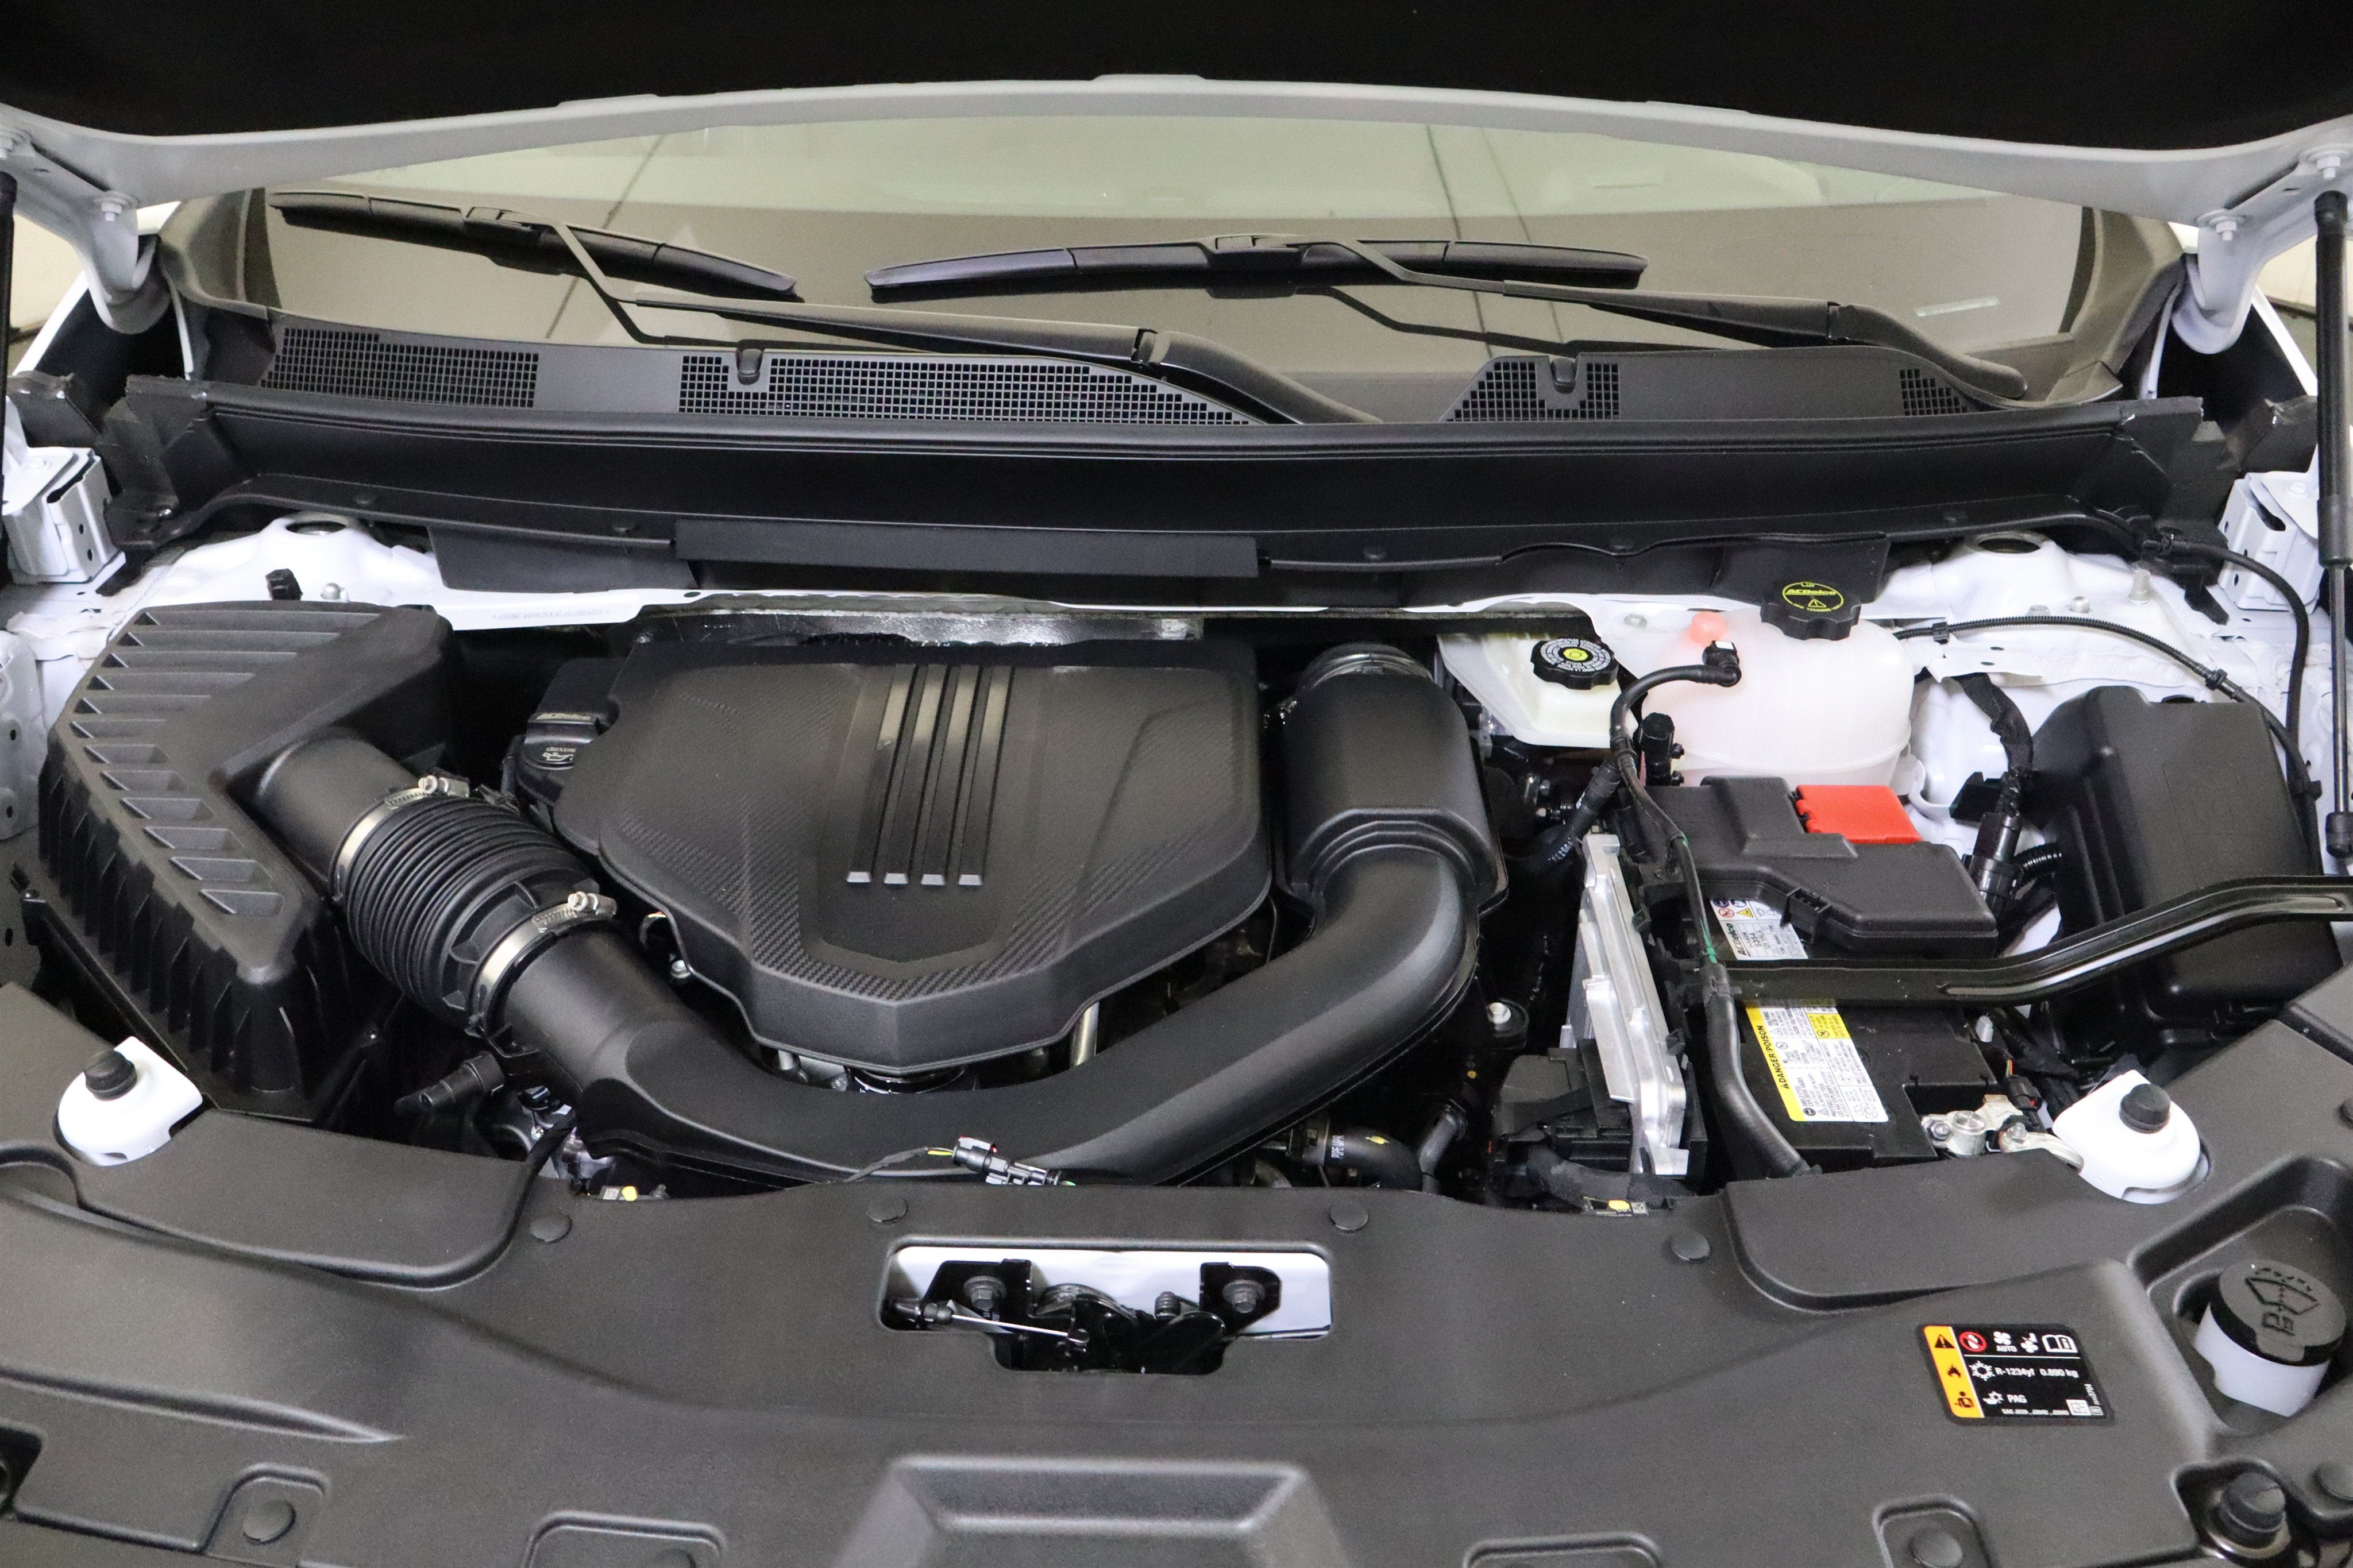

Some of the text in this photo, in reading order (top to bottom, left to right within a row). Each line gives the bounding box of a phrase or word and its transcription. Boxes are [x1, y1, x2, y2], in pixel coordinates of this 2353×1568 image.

[1723, 923, 1749, 956] ACDelco
[1749, 932, 1761, 947] 9354
[1756, 1025, 1786, 1082] DANGER/POISON
[1995, 1368, 2035, 1377] R-1234yf
[2066, 1369, 2079, 1378] kg
[2007, 1394, 2027, 1403] PAG
